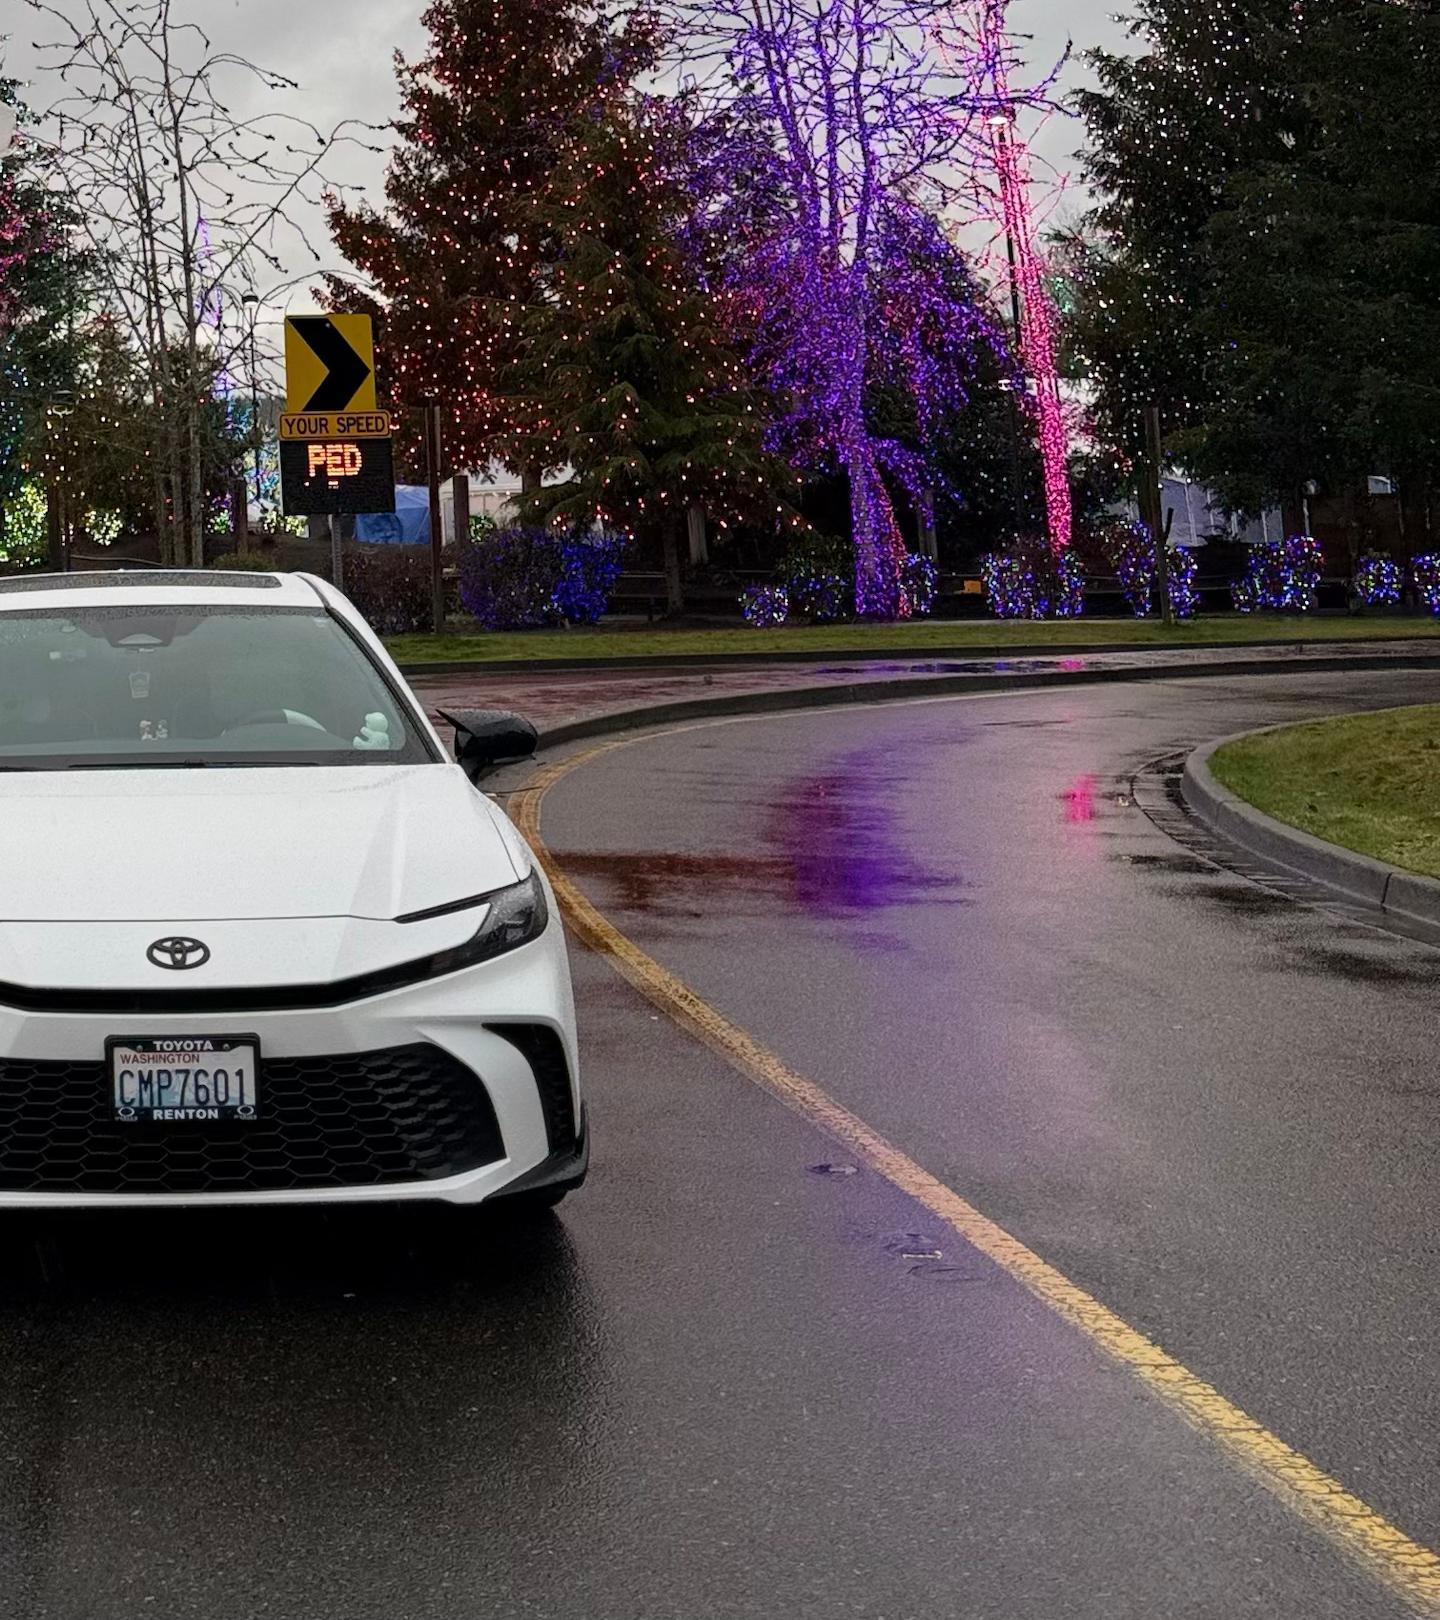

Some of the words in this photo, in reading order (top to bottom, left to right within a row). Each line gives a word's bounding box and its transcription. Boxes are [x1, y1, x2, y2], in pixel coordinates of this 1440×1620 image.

[284, 416, 329, 435] YOUR
[337, 415, 385, 434] SPEED
[307, 444, 363, 477] PED
[152, 1040, 214, 1052] TOYOTA
[120, 1053, 200, 1065] WASHINGTON
[118, 1067, 246, 1107] CMP7601
[152, 1108, 219, 1120] RENTON
